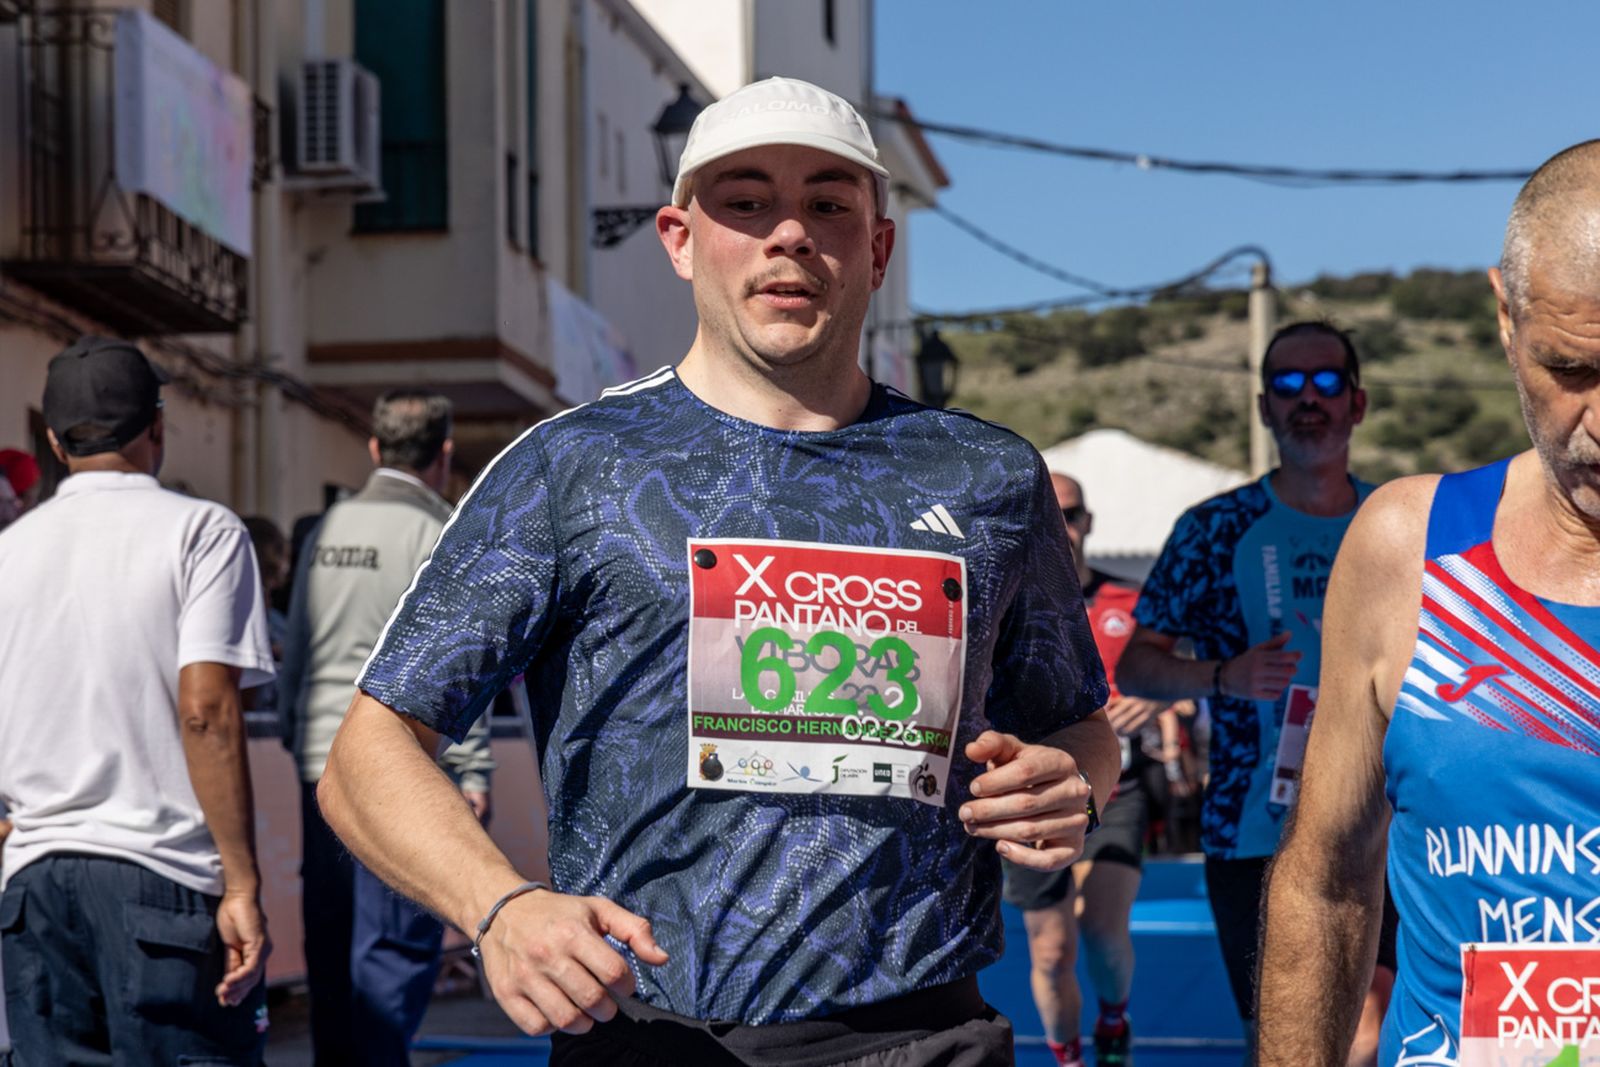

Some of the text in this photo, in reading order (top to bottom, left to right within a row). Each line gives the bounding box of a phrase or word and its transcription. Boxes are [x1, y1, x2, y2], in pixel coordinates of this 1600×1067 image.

[723, 99, 847, 124] ALOMON
[732, 553, 923, 612] X CROSS
[734, 600, 892, 638] PANTANO
[896, 619, 922, 635] DEL
[740, 627, 918, 721] 623
[693, 715, 792, 735] FRANCISCO
[1498, 961, 1539, 1012] X
